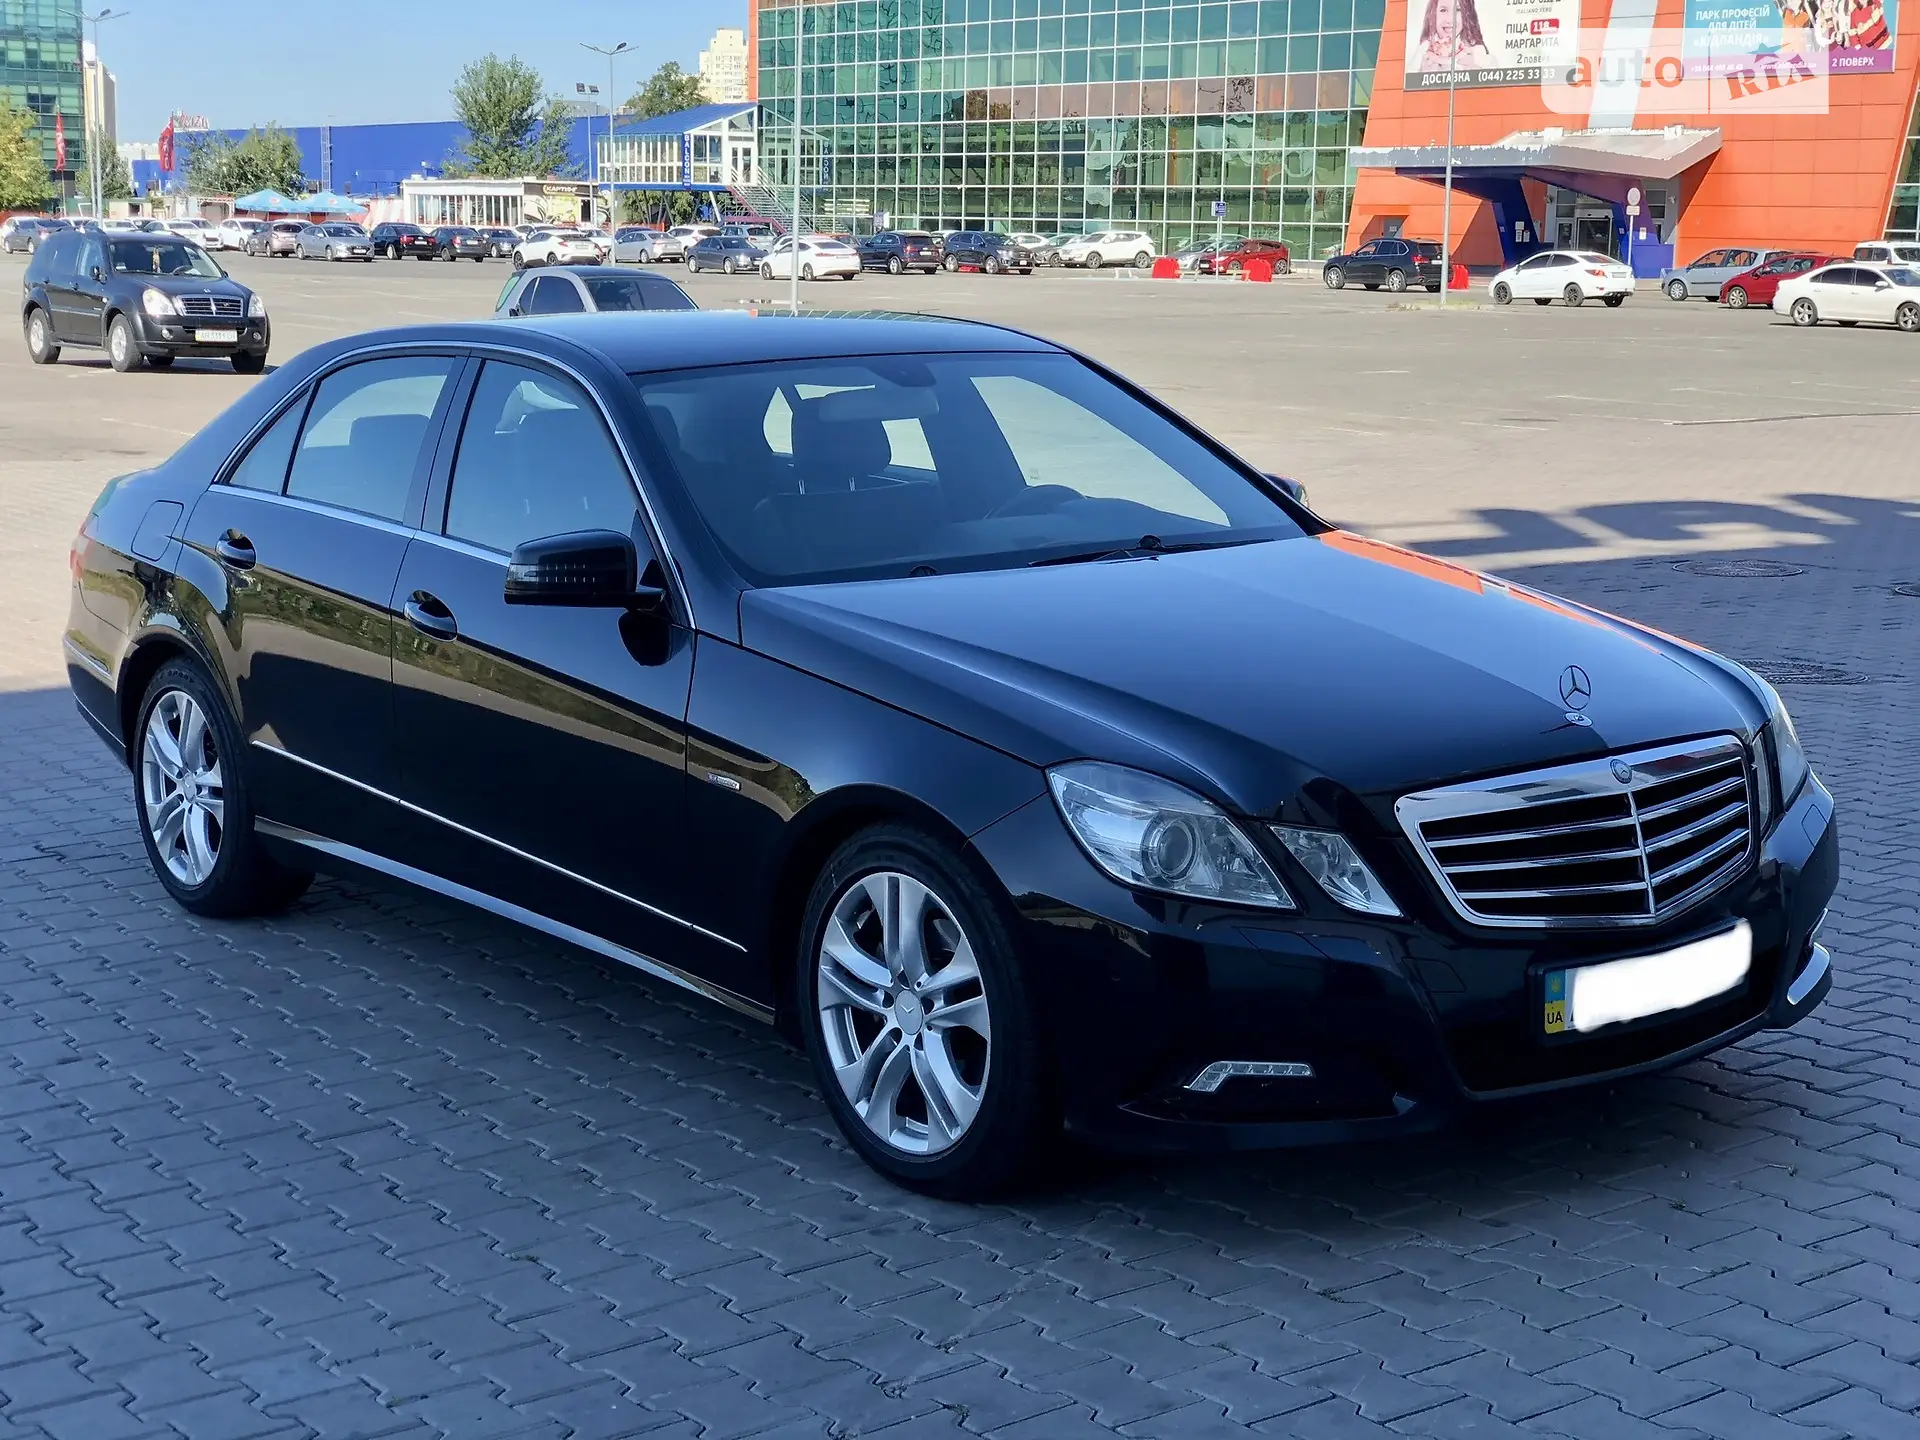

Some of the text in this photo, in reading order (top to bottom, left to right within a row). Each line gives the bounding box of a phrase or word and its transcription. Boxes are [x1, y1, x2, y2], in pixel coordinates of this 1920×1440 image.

[1695, 4, 1770, 20] ПАРК ПРОФЕСІЙ
[1505, 20, 1549, 34] ПІЦА 118
[1708, 17, 1757, 31] ДЛЯ ДІТЕЙ
[1505, 37, 1559, 49] МАРГАРИТА
[1516, 54, 1522, 63] 2
[1832, 56, 1875, 67] 2 ПОВЕРХ
[1421, 68, 1556, 86] ДОСТАВКА (044) 225 33 33
[1547, 1010, 1564, 1025] UA
